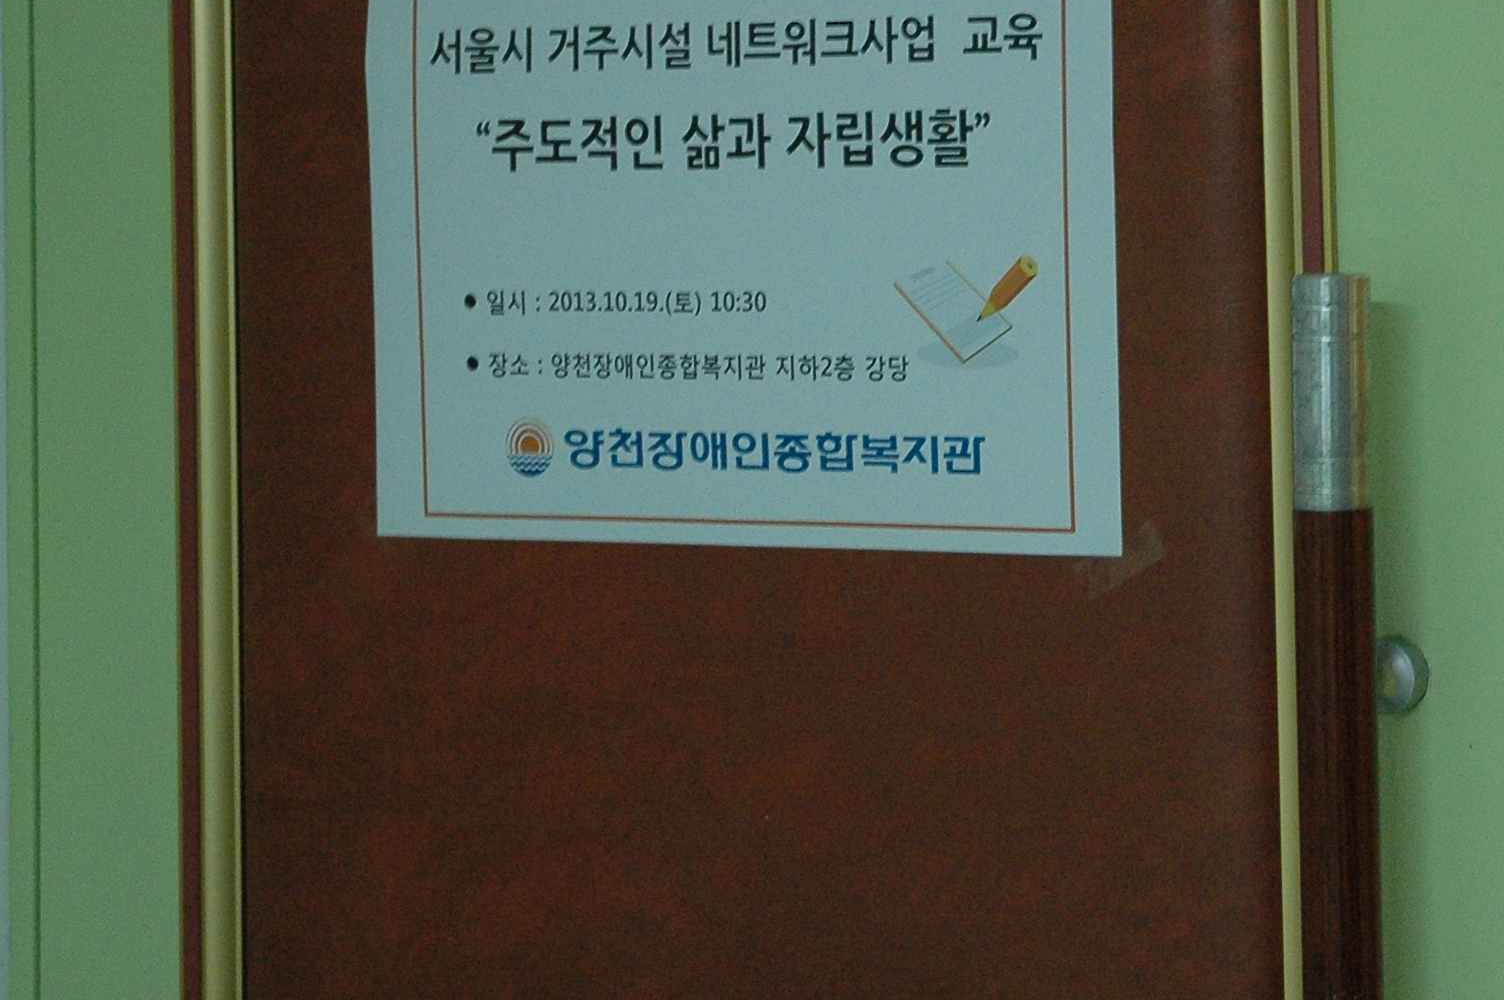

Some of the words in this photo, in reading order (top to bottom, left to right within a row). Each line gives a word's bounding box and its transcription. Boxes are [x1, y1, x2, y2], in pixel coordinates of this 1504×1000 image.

[429, 24, 533, 76] 서울시
[548, 20, 692, 72] 거주시설
[706, 14, 936, 68] 네트워크사업
[962, 12, 1044, 61] 교육
[475, 113, 664, 173] “주도적인
[681, 112, 772, 171] 삶과
[785, 107, 992, 170] 자립생활”
[486, 289, 527, 317] 일시
[548, 289, 702, 317] 2013.10.19.(토)
[710, 290, 768, 313] 10:30
[488, 352, 530, 379] 장소
[550, 352, 767, 382] 양천장애인종합복지관
[775, 353, 855, 383] 지하2층
[865, 354, 910, 383] 강당
[563, 427, 987, 476] 양천장애인종합복지관
